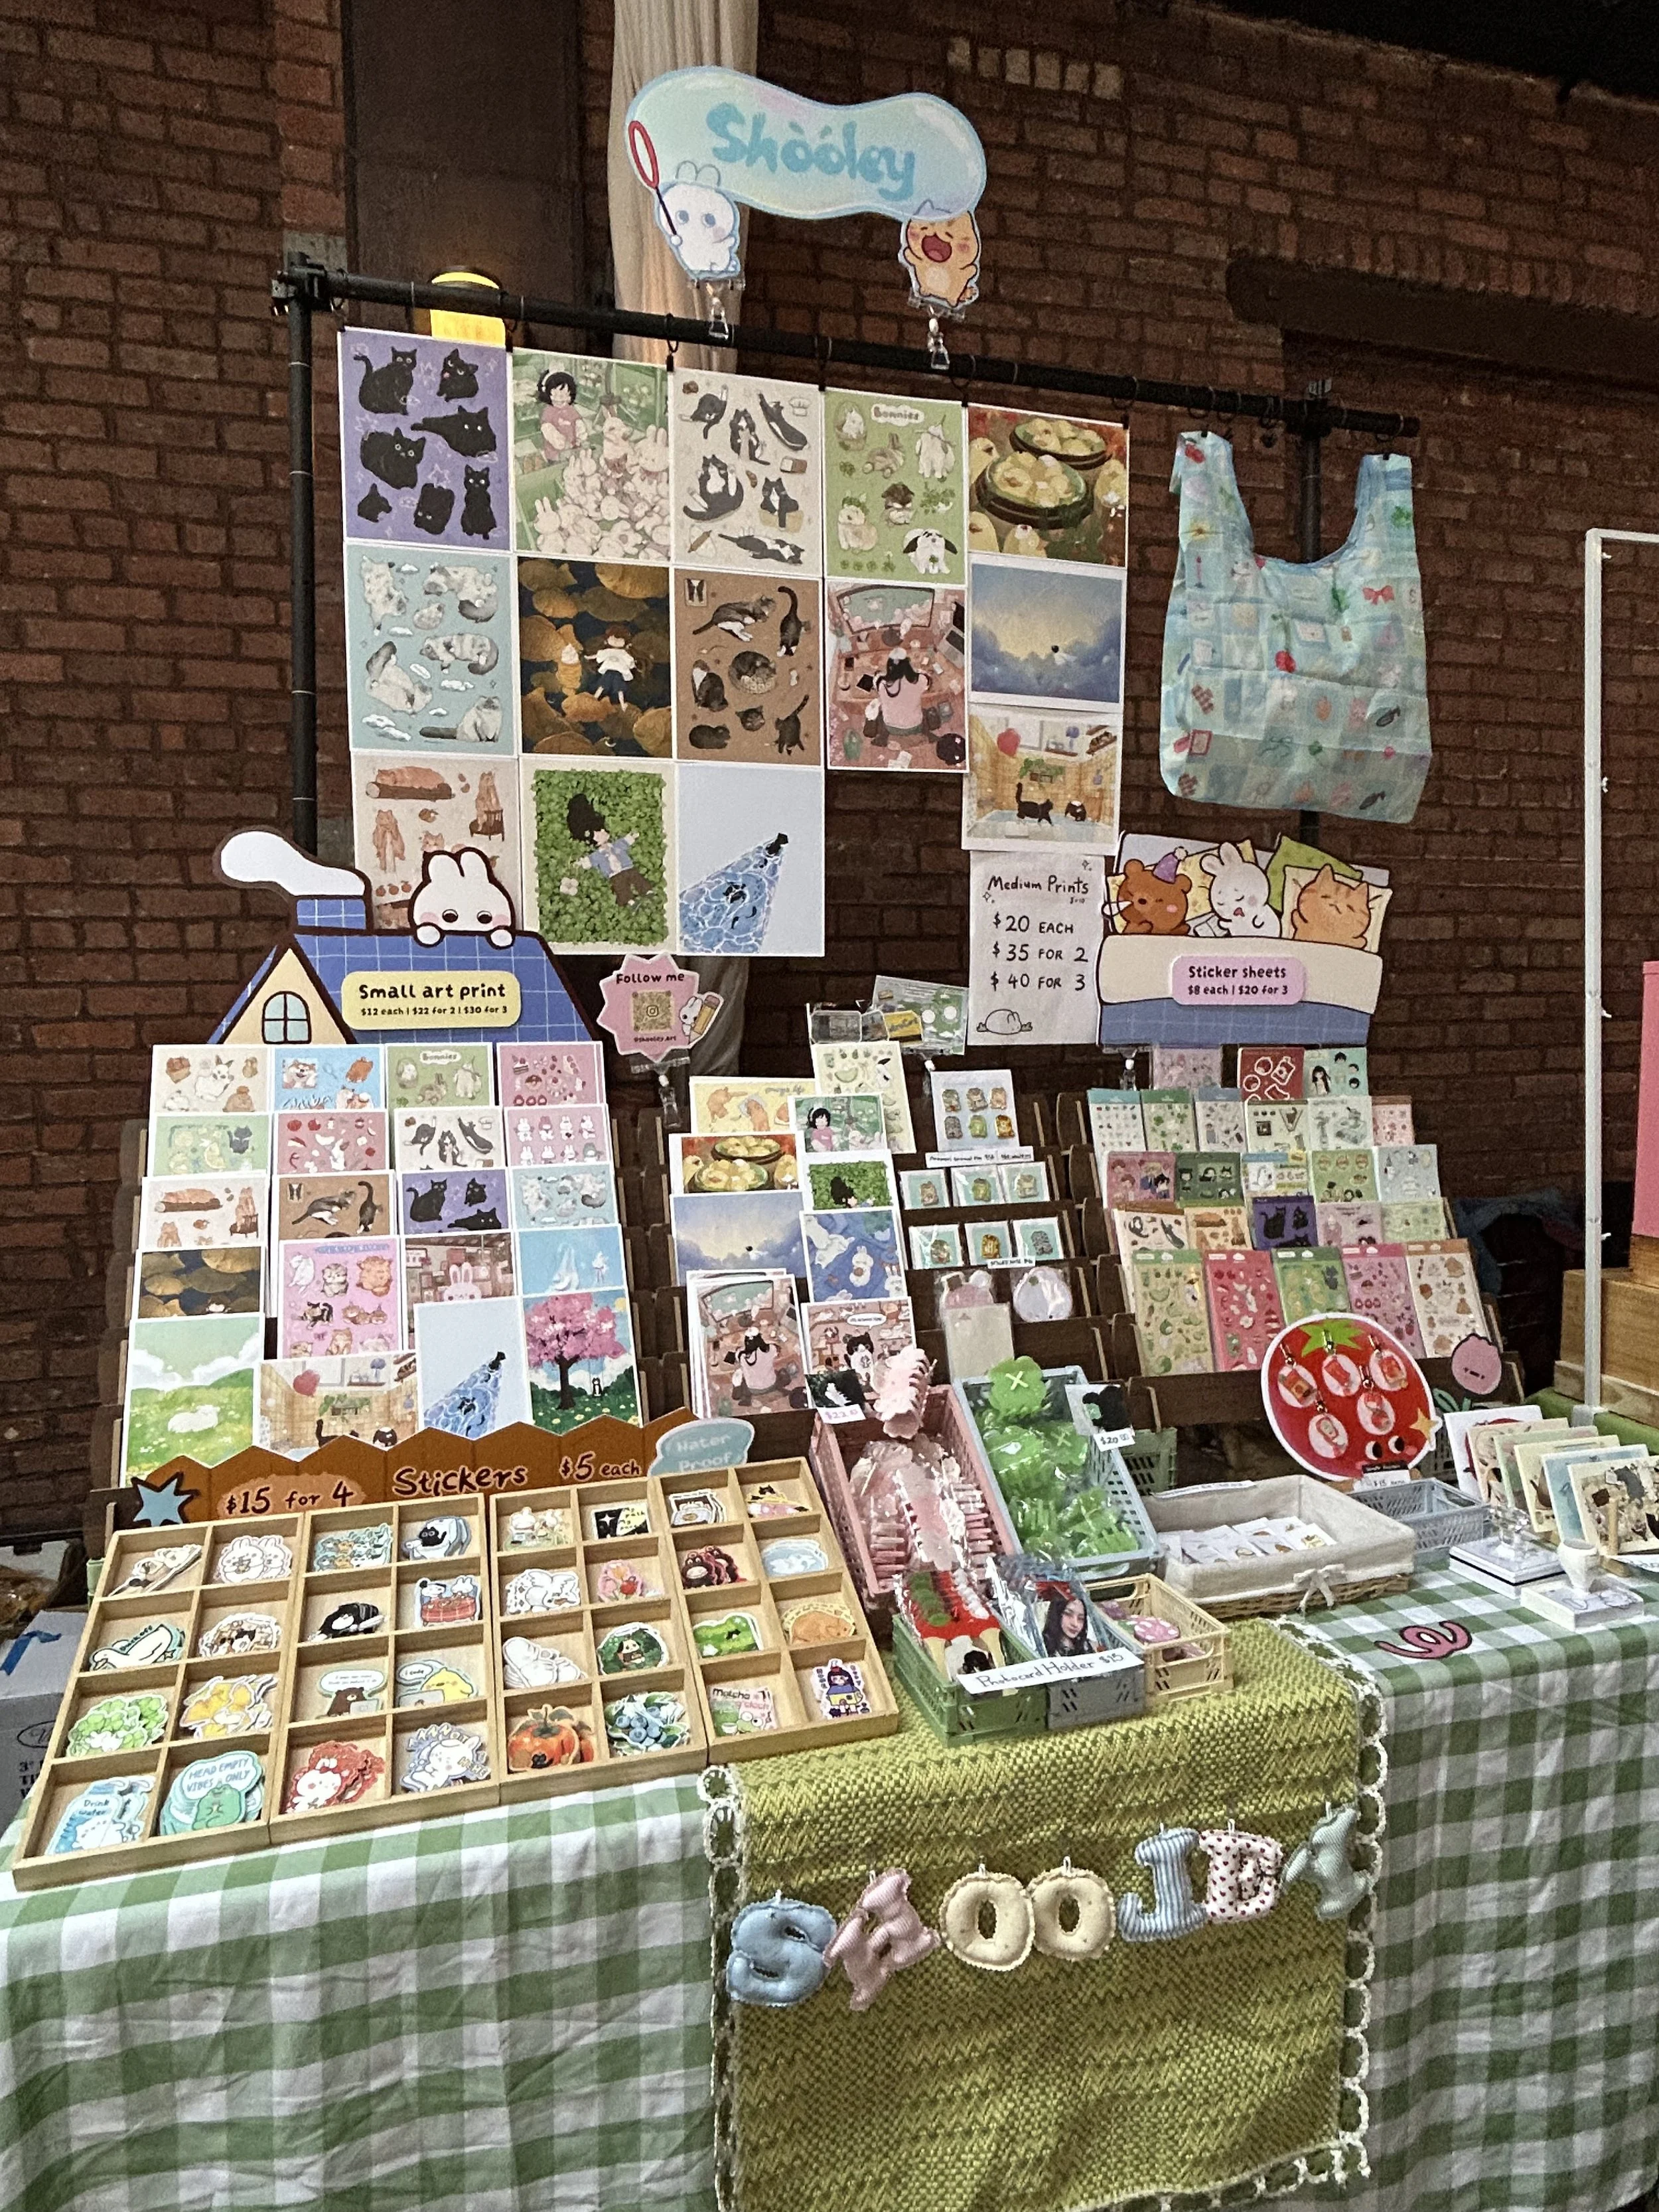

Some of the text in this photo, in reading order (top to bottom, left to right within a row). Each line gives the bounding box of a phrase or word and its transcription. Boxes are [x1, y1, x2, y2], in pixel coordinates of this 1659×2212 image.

[987, 875, 1089, 894] Medium Prints
[1039, 922, 1074, 934] EACH
[1039, 948, 1063, 960] FOR
[1074, 947, 1088, 962] 2
[616, 973, 685, 984] Follow me
[1189, 966, 1286, 978] Sticker sheets
[1038, 977, 1062, 990] FOR
[1074, 974, 1086, 991] 3
[1188, 985, 1288, 995] $8 each $20 for 3
[359, 983, 506, 1001] Small art print
[361, 1007, 378, 1016] $12
[381, 1007, 403, 1015] each
[413, 1007, 429, 1015] $22
[432, 1006, 447, 1015] for
[502, 1005, 507, 1014] 3
[676, 1434, 730, 1451] Water
[561, 1453, 640, 1480] $5 each
[678, 1452, 733, 1471] Proof
[394, 1467, 527, 1497] Stickers
[226, 1481, 354, 1514] $15 for 4
[976, 1653, 1123, 1688] Photocard Holder $15
[188, 1757, 250, 1779] HEAD EMPTY
[186, 1770, 250, 1792] VIBES ONLY
